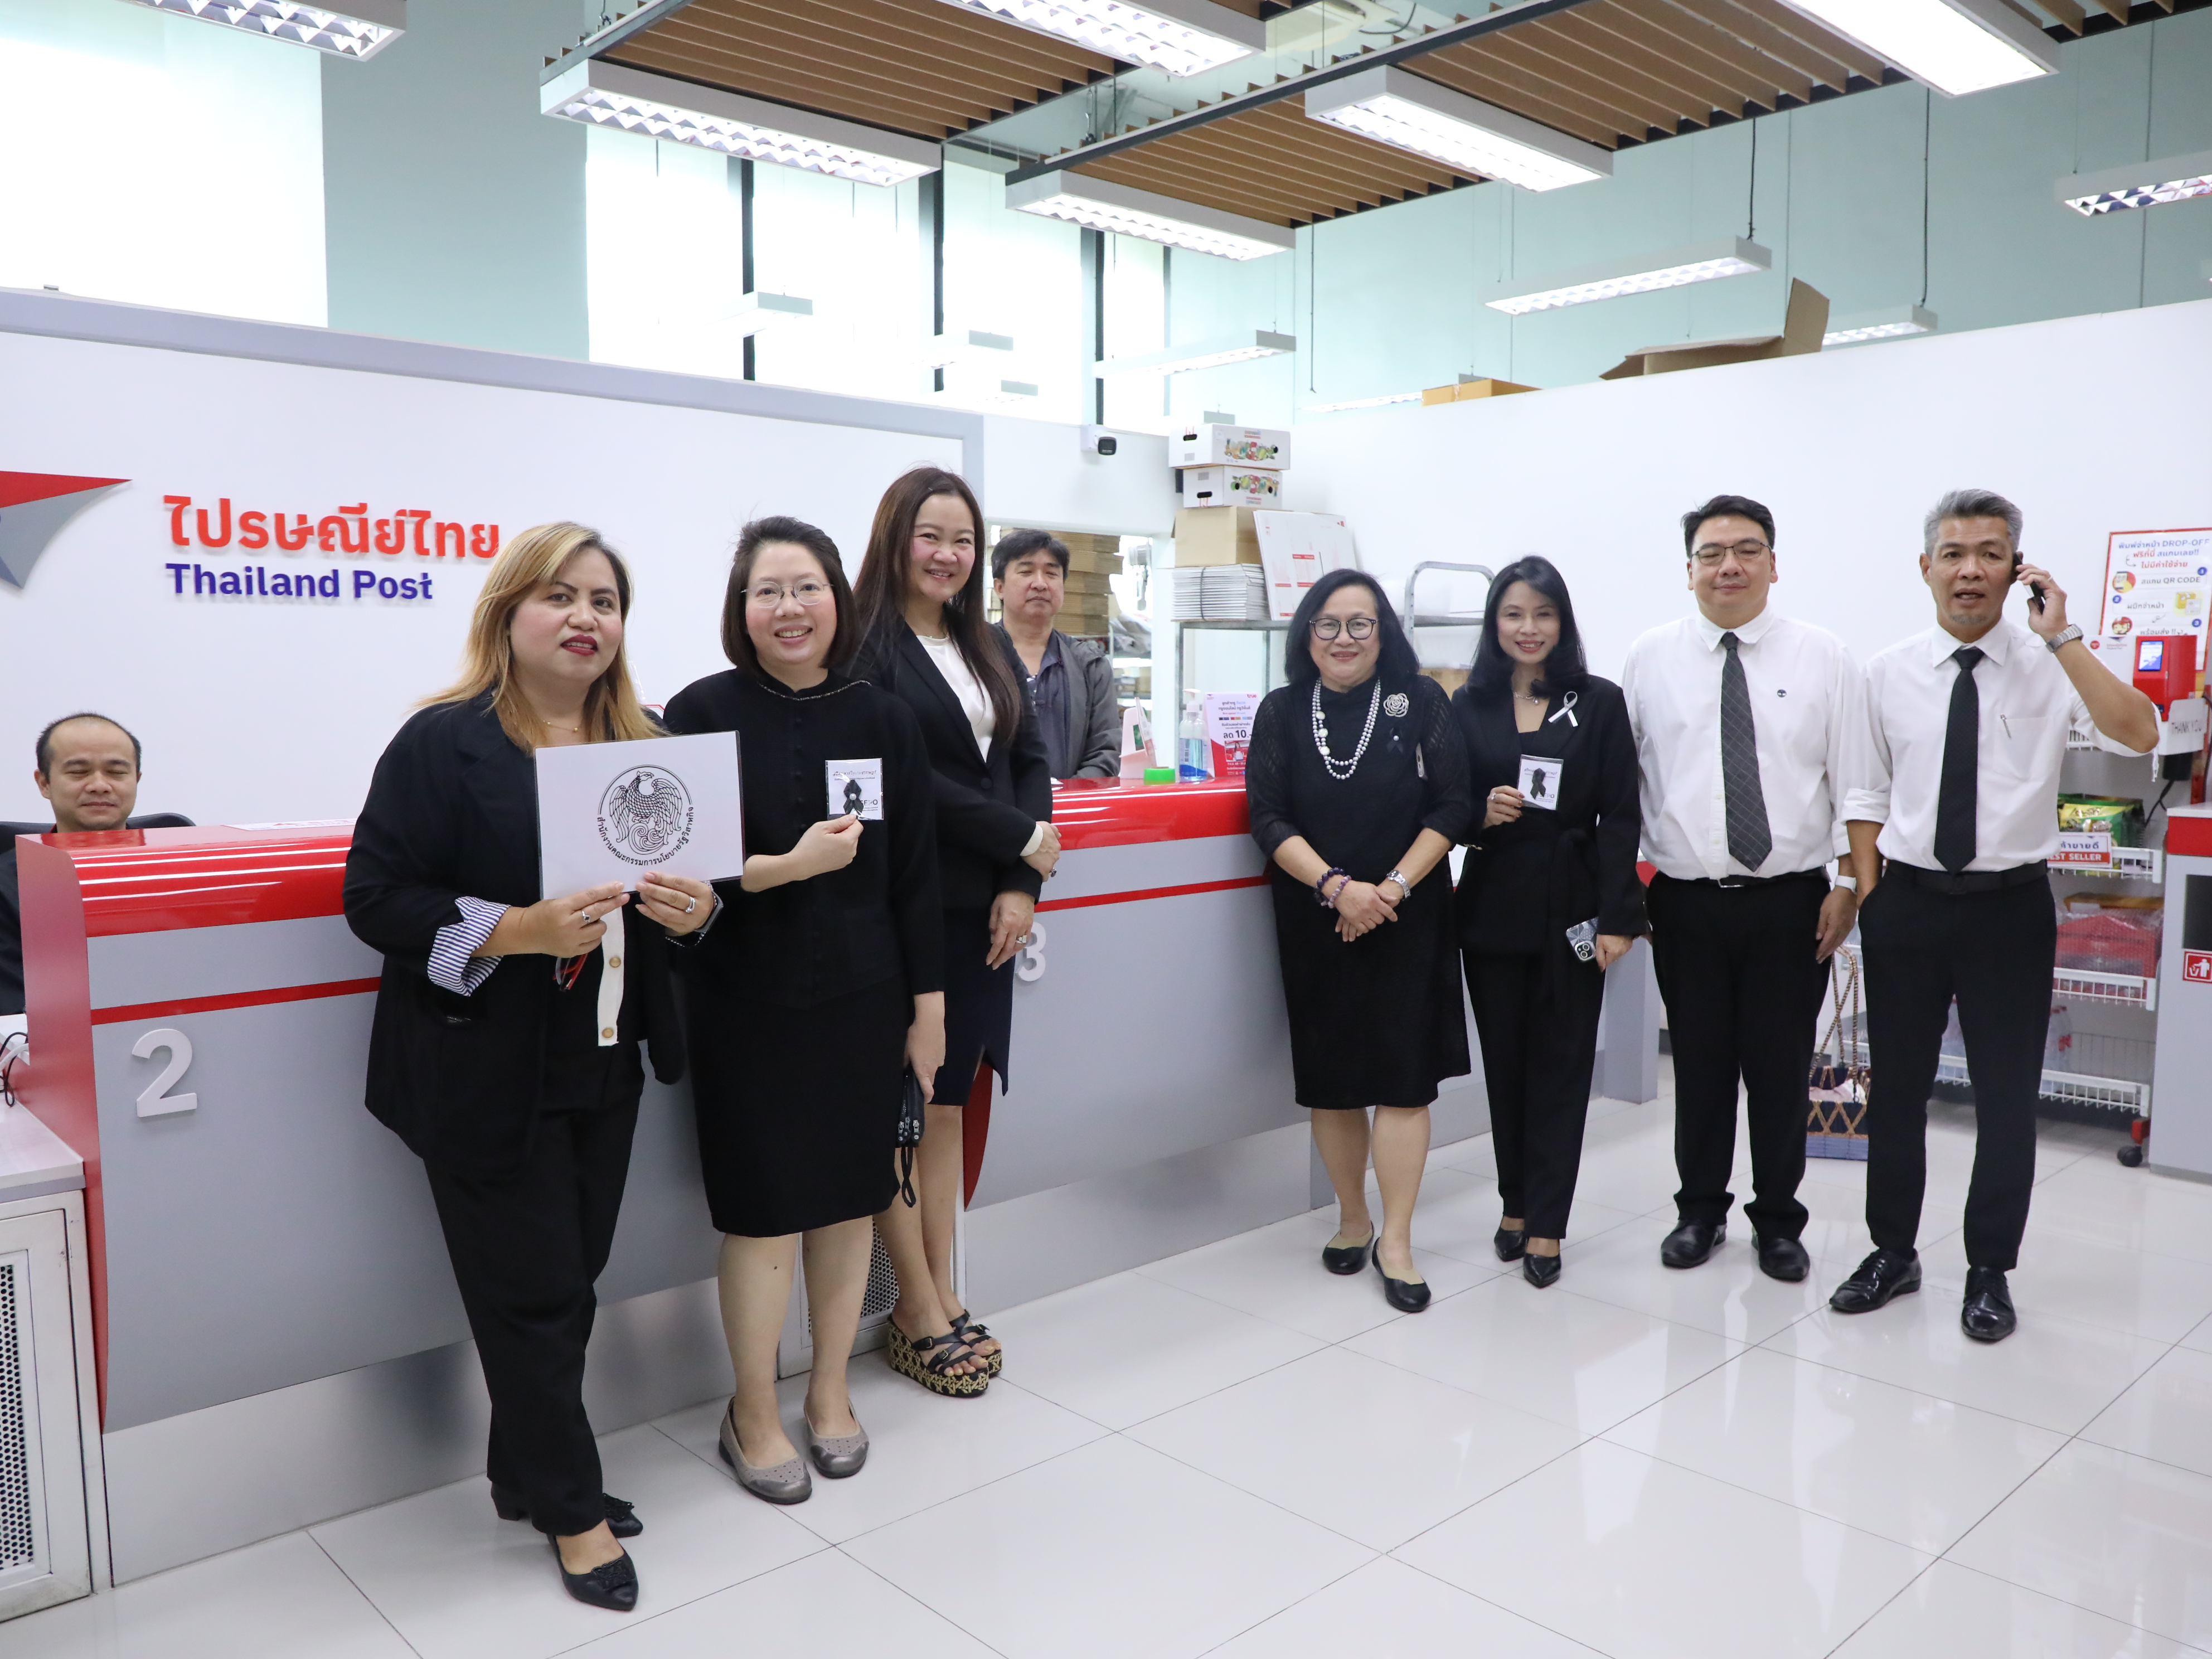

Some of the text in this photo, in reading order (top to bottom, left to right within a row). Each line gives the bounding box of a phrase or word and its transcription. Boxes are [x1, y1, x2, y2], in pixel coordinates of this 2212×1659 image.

[163, 495, 499, 559] ไปรษณีย์ไทย
[2162, 538, 2210, 547] DROP-OFF
[166, 563, 433, 600] Thailand Post
[1016, 921, 1046, 982] 3
[132, 1029, 197, 1118] 2
